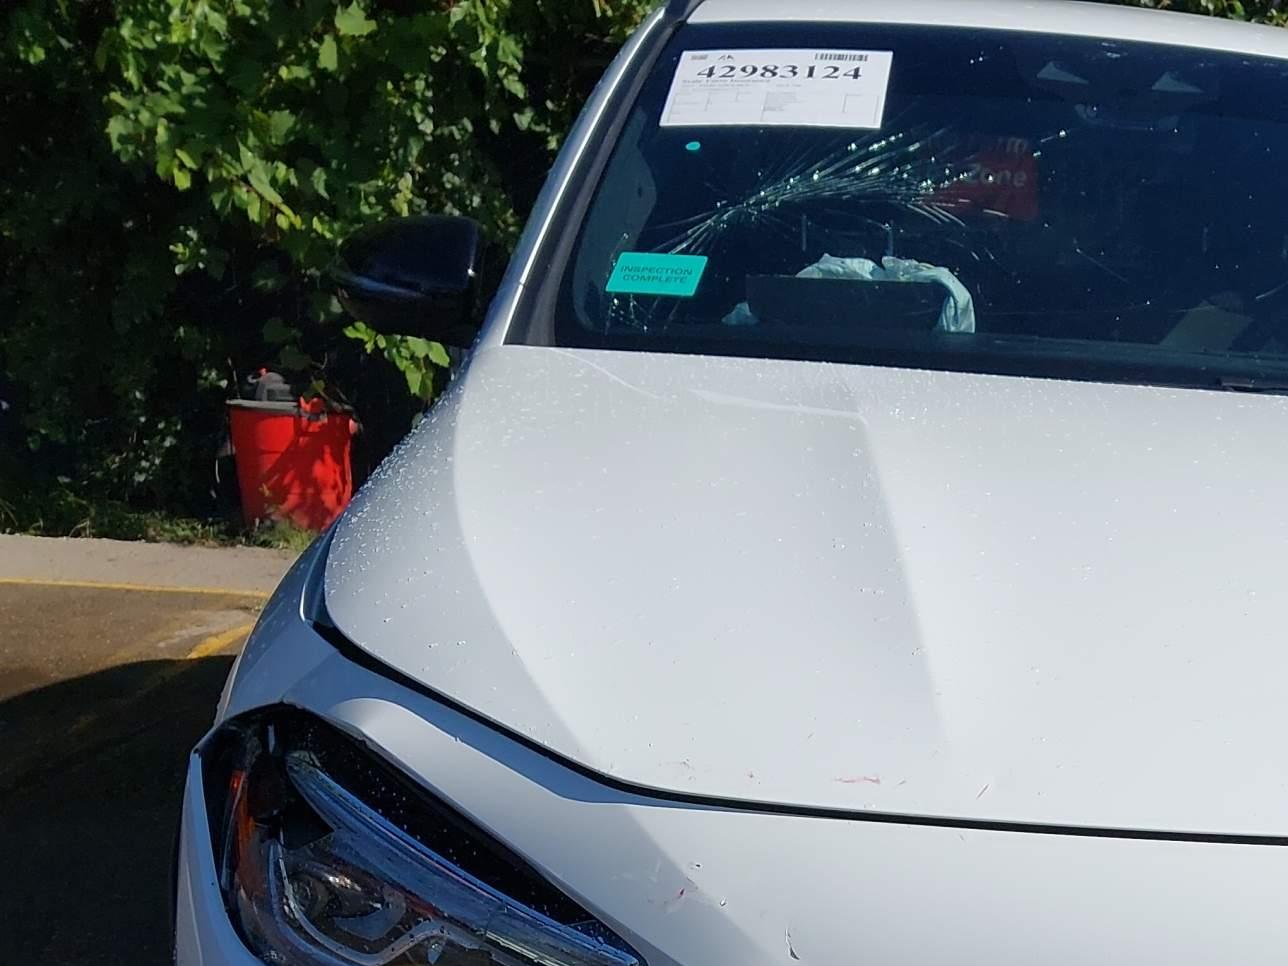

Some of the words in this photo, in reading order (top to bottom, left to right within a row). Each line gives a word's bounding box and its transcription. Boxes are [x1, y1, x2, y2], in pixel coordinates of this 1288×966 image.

[697, 64, 862, 80] 42983124
[620, 265, 693, 276] INSPECTION
[622, 274, 689, 284] COMPLETE
